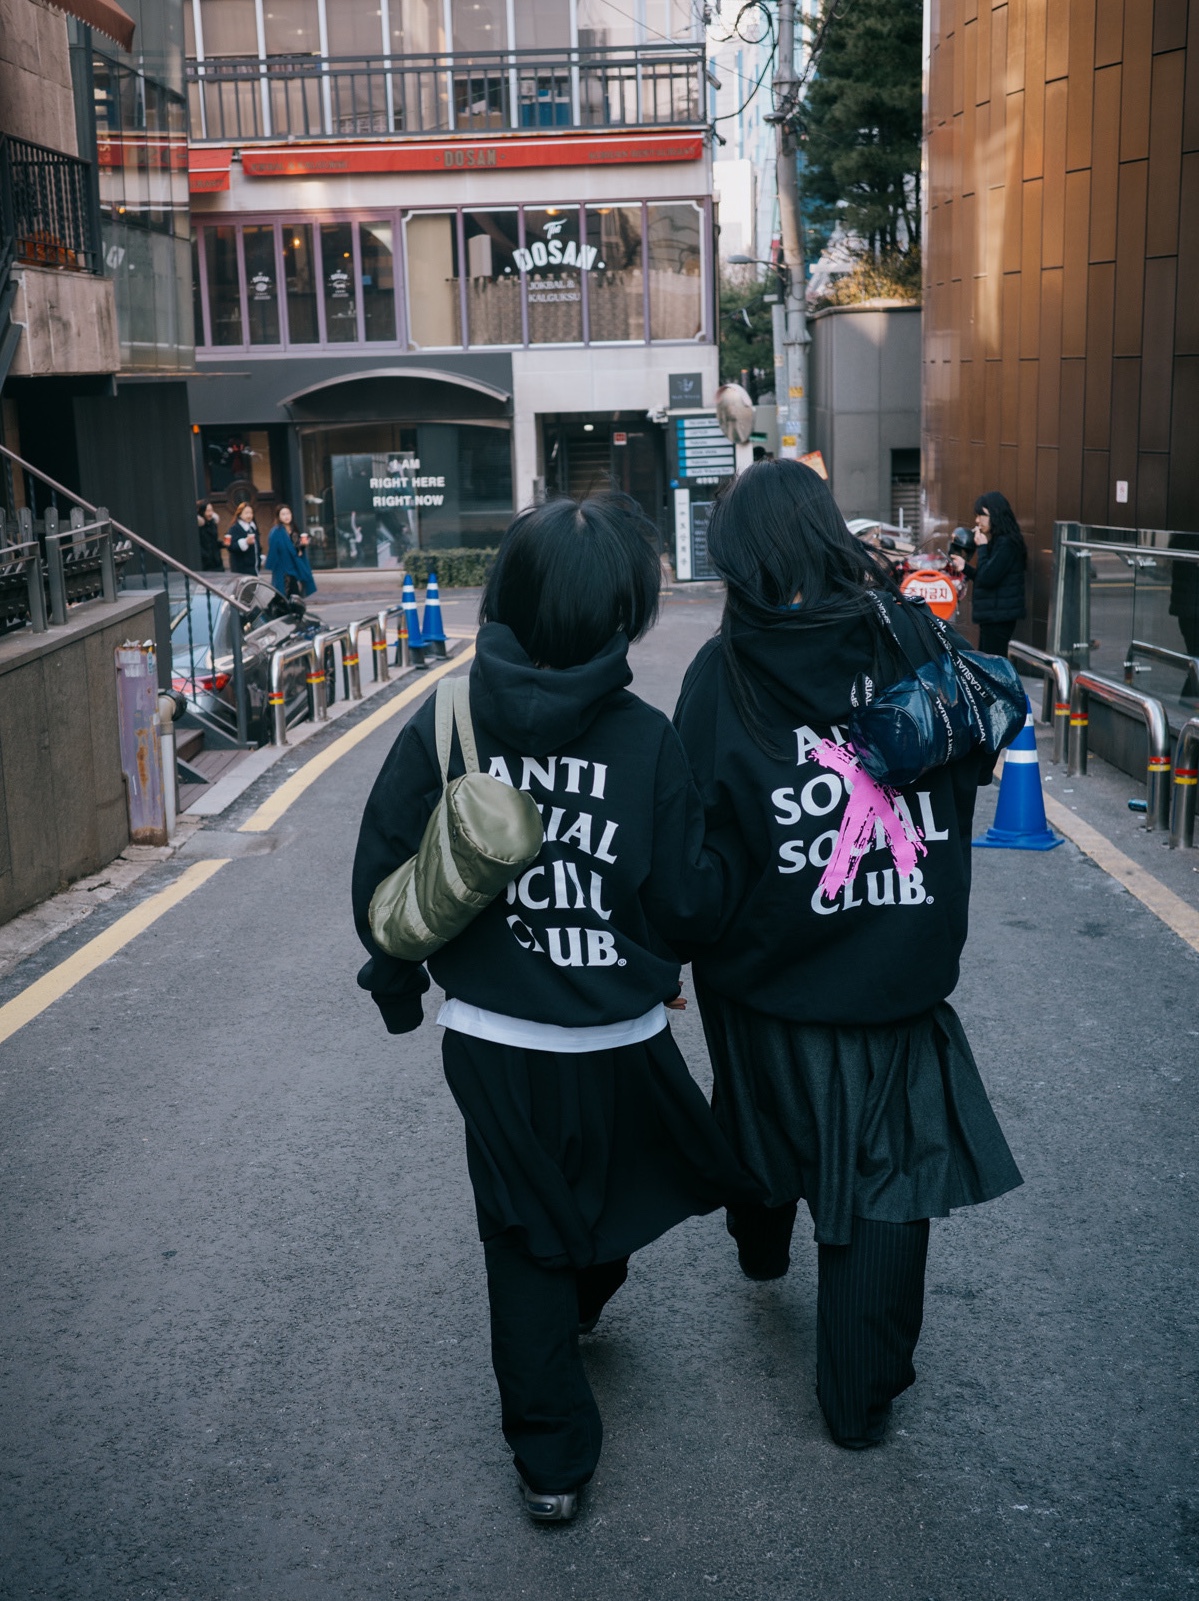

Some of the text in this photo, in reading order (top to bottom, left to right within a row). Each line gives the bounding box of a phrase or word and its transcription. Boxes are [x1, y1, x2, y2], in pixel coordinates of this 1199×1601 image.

[444, 149, 497, 167] DOSAN
[543, 218, 567, 239] The
[512, 240, 598, 272] DOSAN
[402, 459, 420, 469] AM
[370, 476, 445, 488] RIGHT HERE
[373, 495, 444, 507] RIGHT NOW
[909, 587, 948, 600] 주차금지
[956, 656, 982, 692] CASUAL
[865, 676, 873, 706] SUAL
[936, 697, 953, 737] CASUAL
[488, 756, 608, 800] ANTI
[537, 804, 619, 865] IAL
